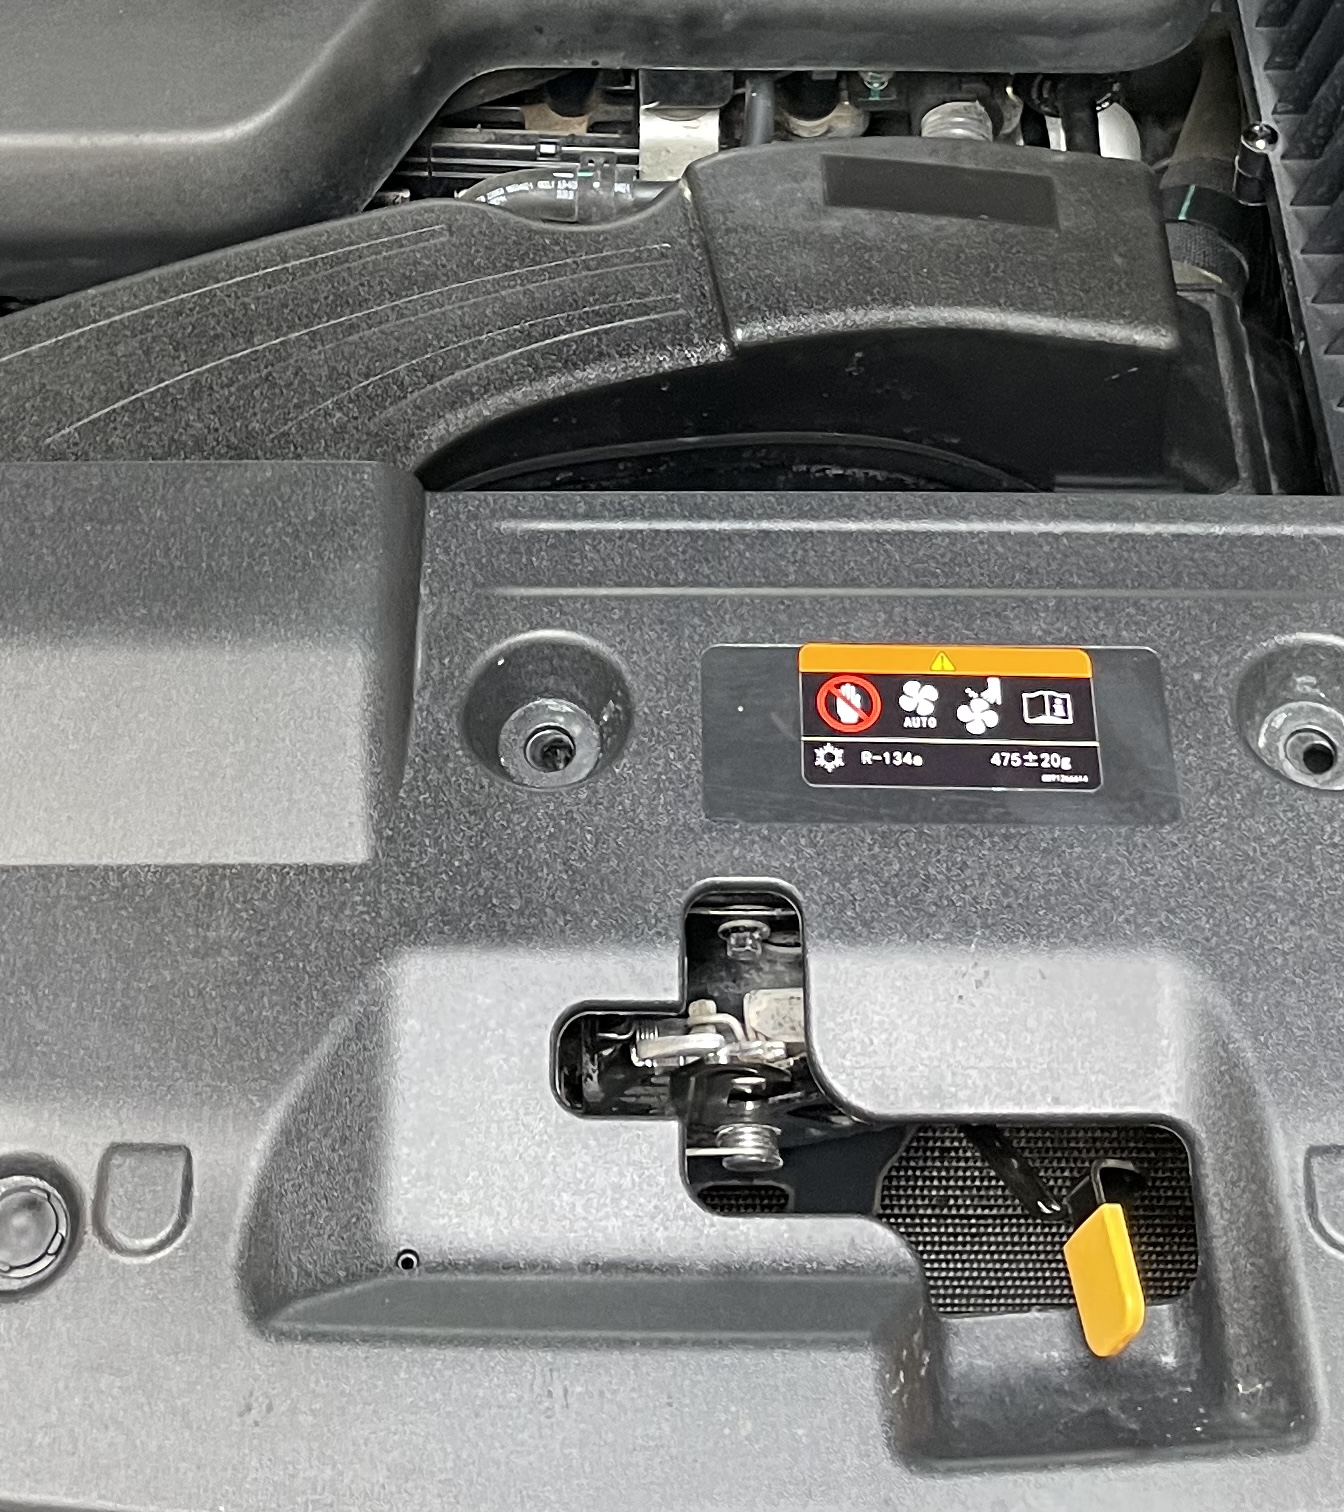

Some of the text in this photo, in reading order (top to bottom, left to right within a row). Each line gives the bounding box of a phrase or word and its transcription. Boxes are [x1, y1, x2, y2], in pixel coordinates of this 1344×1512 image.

[903, 716, 937, 729] AUTO
[860, 749, 1073, 770] R-134a 475±20g
